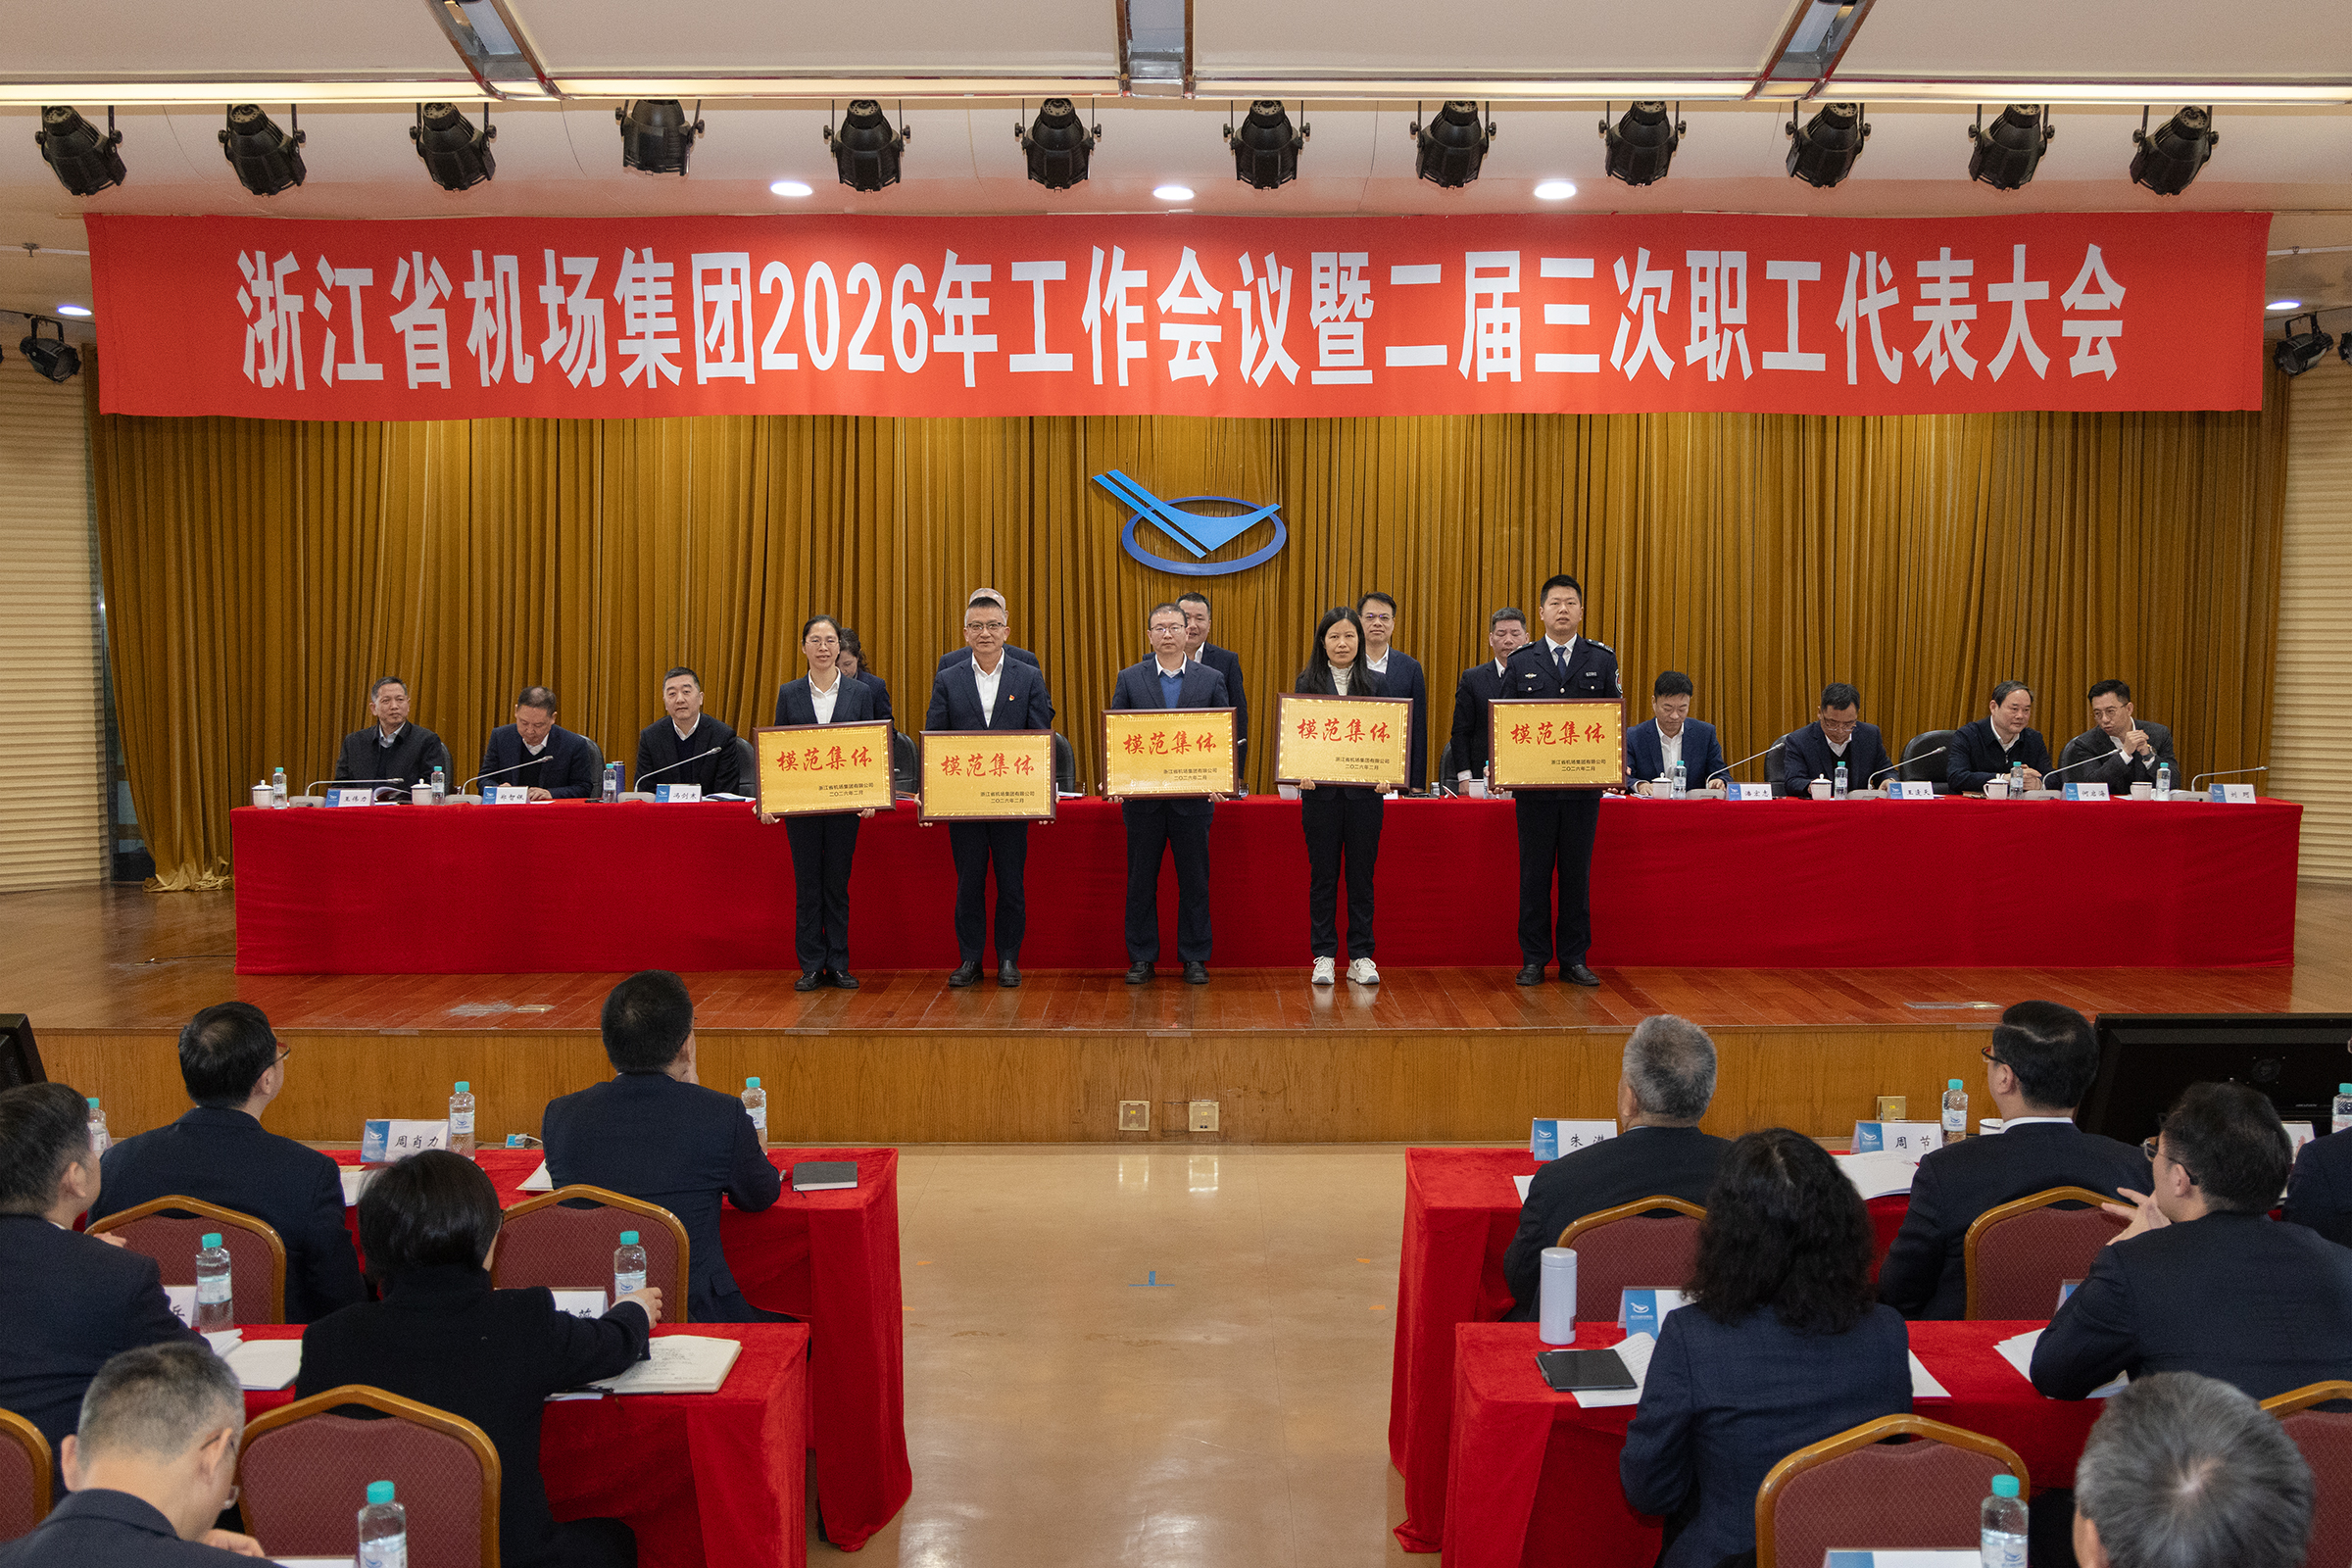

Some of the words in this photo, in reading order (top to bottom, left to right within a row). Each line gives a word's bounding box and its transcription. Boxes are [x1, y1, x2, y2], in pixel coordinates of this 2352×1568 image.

[238, 245, 2125, 390] 浙江省机场集团2026年工作会议暨二届三次职工代表大会
[1122, 730, 1217, 755] 模范集体
[1297, 717, 1391, 744] 模范集体
[1510, 720, 1605, 746] 模范集体
[776, 746, 873, 772] 模范集体
[940, 752, 1035, 777] 模范集体
[394, 1134, 440, 1150] 周肖力
[1894, 1134, 1932, 1152] 周节
